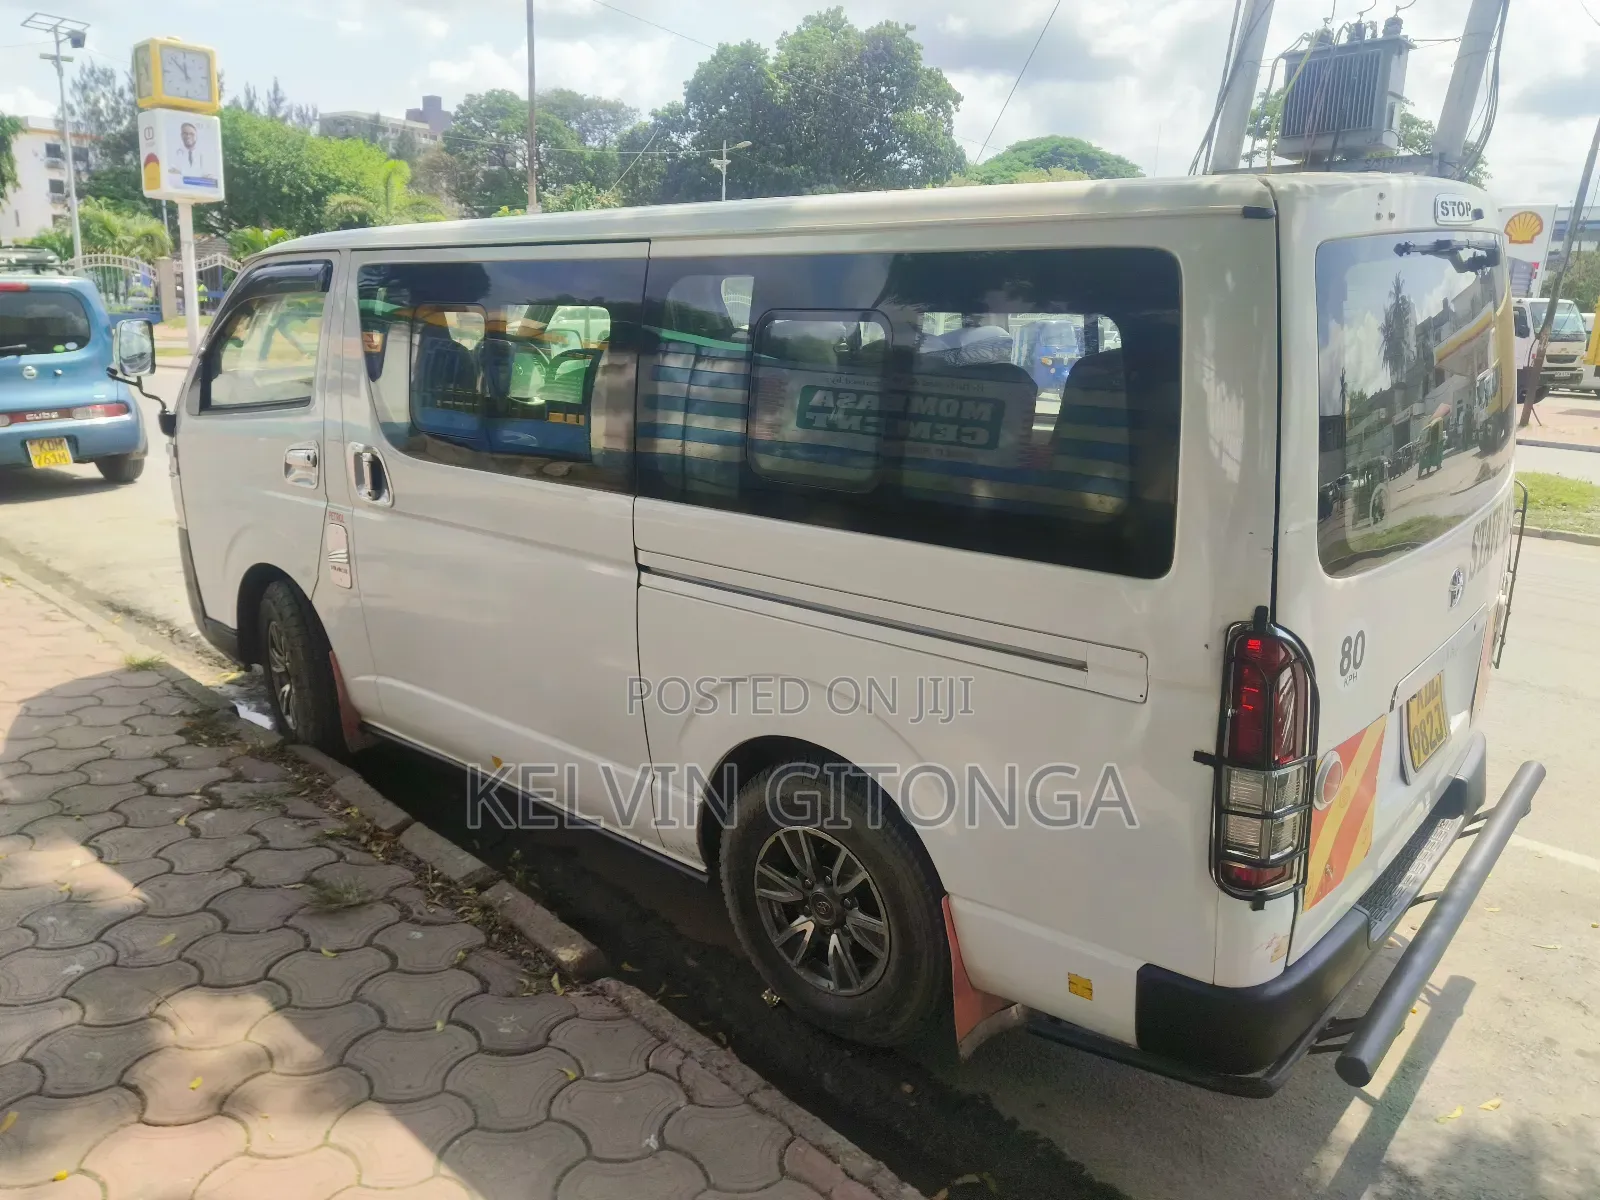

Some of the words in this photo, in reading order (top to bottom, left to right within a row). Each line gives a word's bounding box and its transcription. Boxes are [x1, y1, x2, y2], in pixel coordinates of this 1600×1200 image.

[1440, 200, 1472, 217] STOP
[1339, 629, 1366, 677] 80
[1343, 671, 1358, 688] KPH
[1412, 703, 1445, 765] 982J
